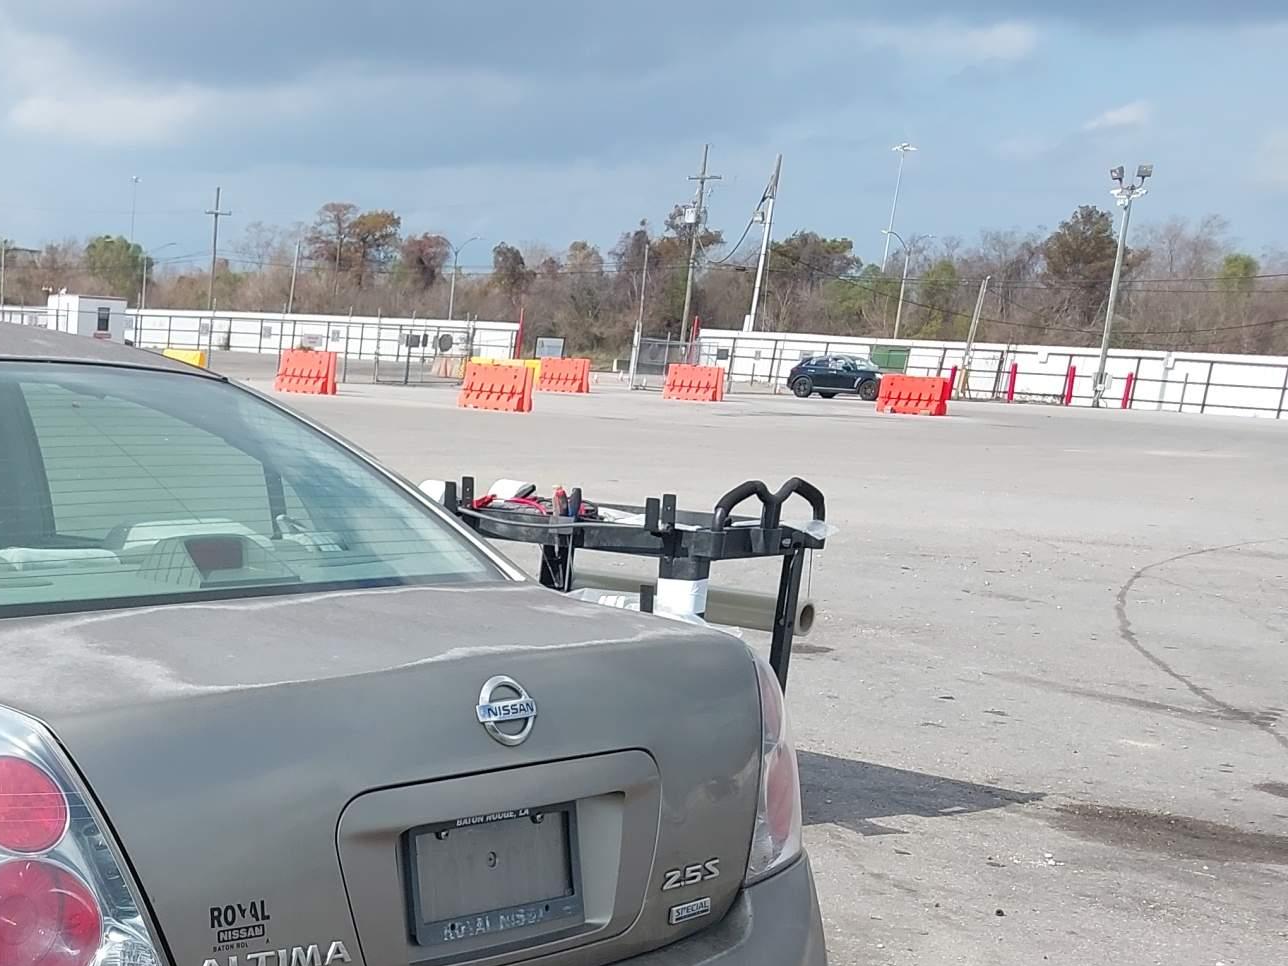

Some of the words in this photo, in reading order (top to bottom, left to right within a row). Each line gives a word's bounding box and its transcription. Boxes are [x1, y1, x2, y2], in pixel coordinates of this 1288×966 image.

[486, 702, 534, 718] NISSAN
[210, 900, 271, 928] ROYAL
[675, 901, 709, 917] SPECIAL
[219, 926, 264, 942] NISSAN
[213, 943, 234, 953] BATON
